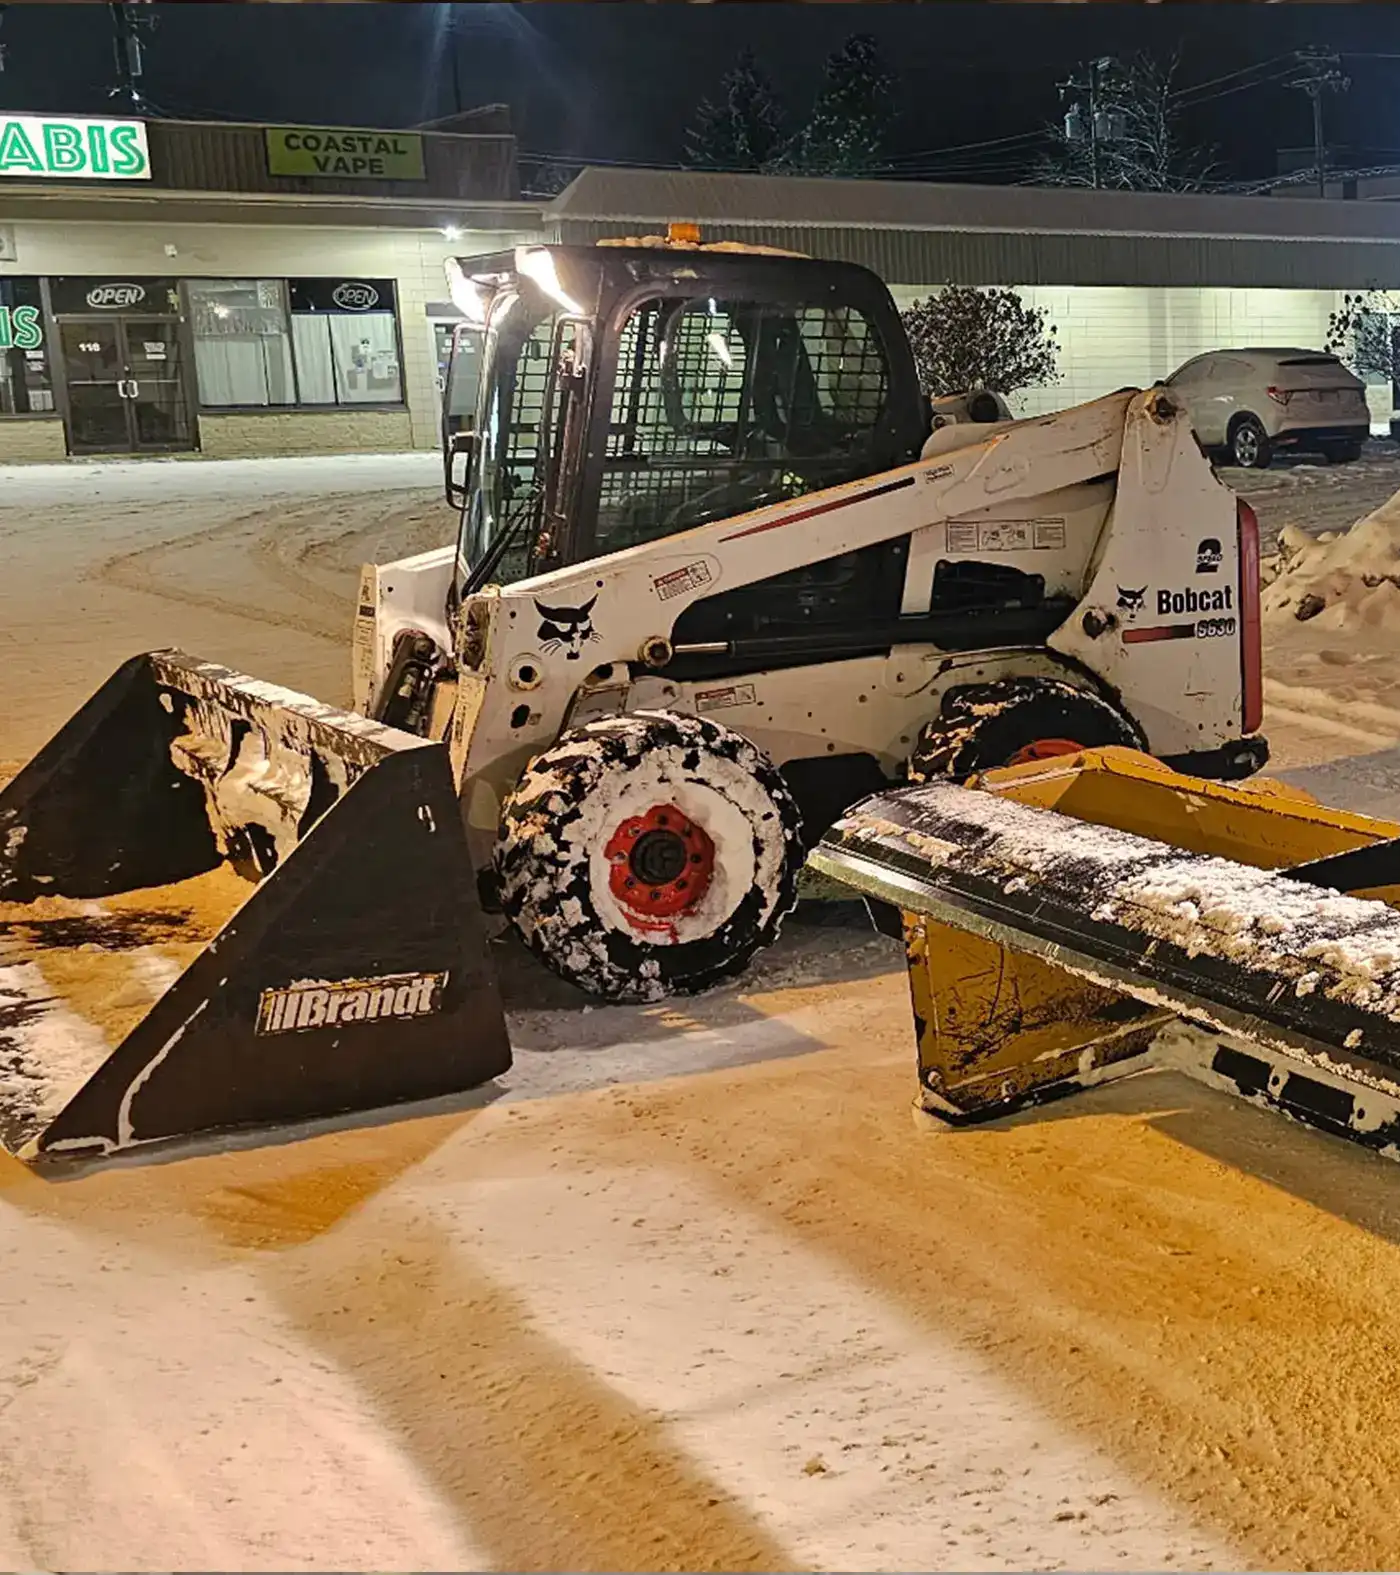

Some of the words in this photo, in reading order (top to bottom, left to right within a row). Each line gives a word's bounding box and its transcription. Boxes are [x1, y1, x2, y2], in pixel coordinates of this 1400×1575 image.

[0, 122, 146, 175] ABIS
[284, 133, 408, 155] COASTAL
[312, 155, 385, 175] VAPE
[90, 288, 139, 304] OPEN
[337, 286, 376, 305] OPEN
[1157, 585, 1233, 615] Bobcat
[1197, 617, 1236, 639] S630
[296, 977, 437, 1029] Brandt
